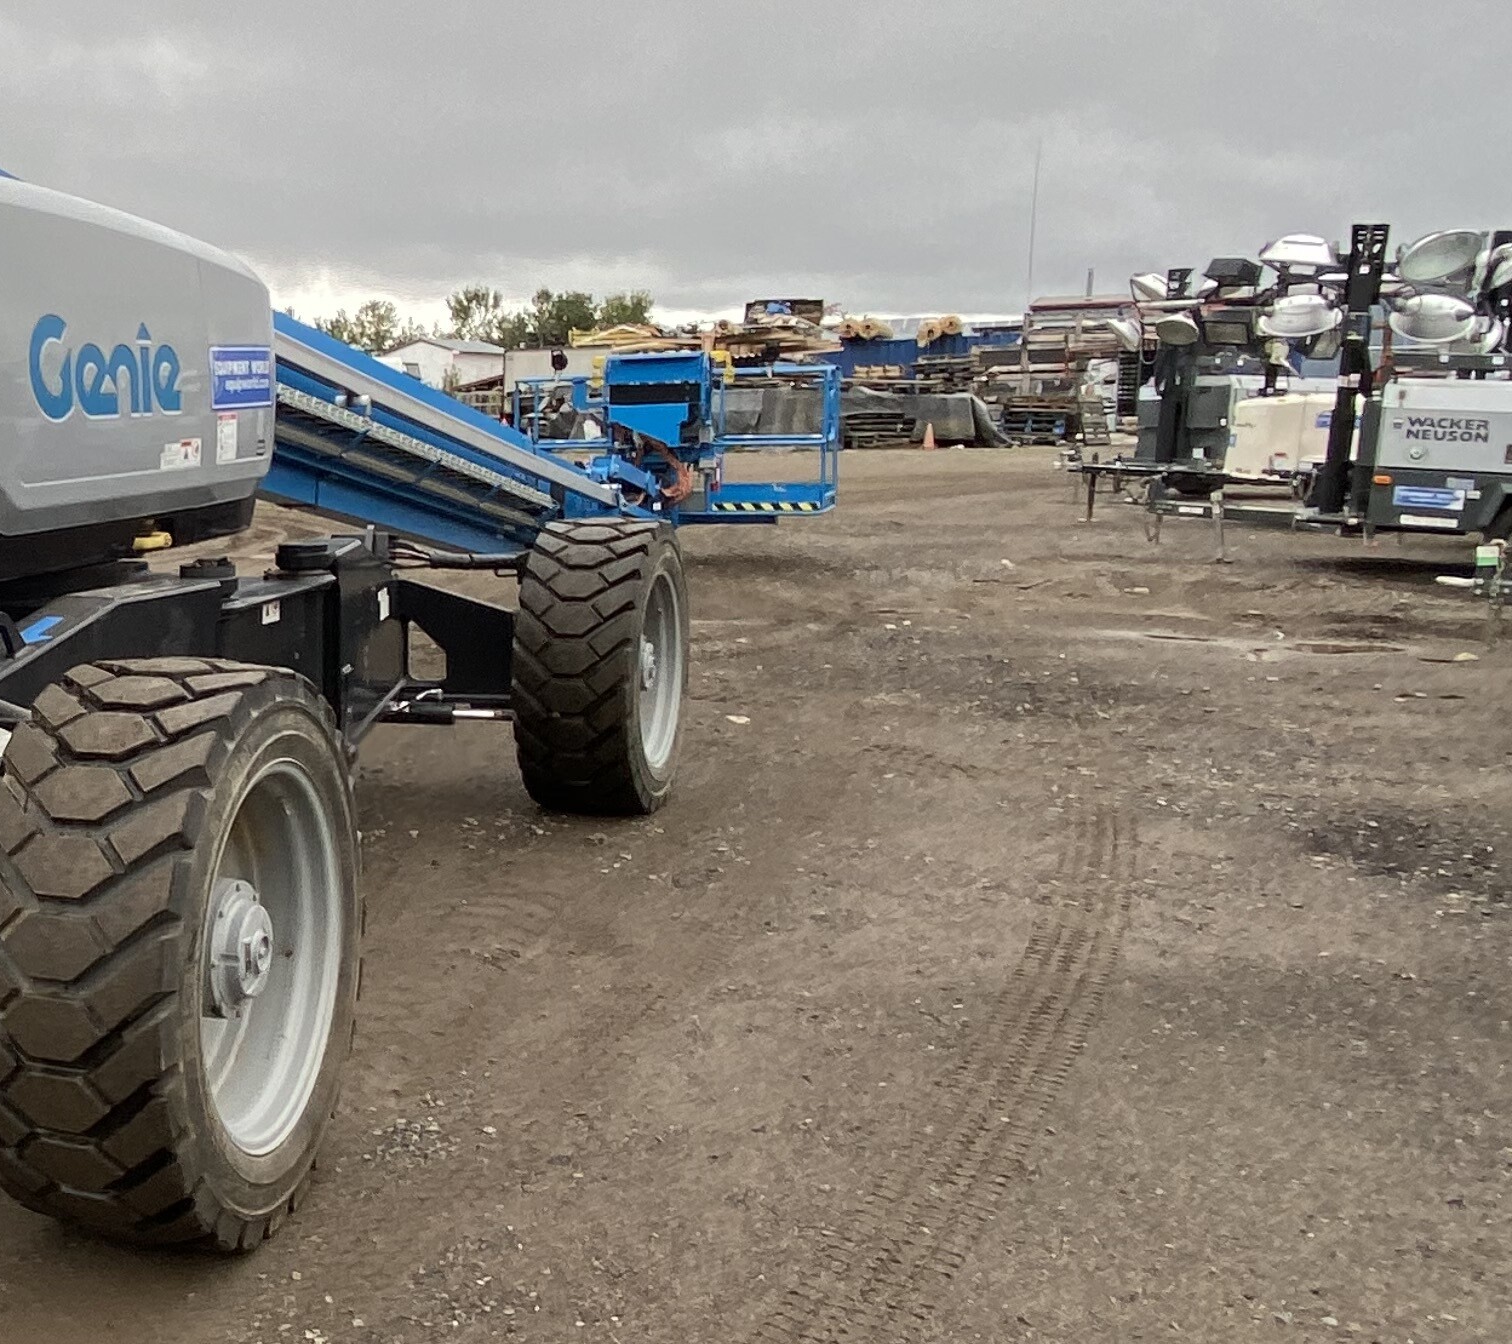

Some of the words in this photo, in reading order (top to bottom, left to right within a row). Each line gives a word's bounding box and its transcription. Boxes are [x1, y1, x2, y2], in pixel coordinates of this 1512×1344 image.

[29, 313, 182, 422] Genie
[1407, 417, 1490, 431] WACKER
[1406, 429, 1489, 443] NEUSON
